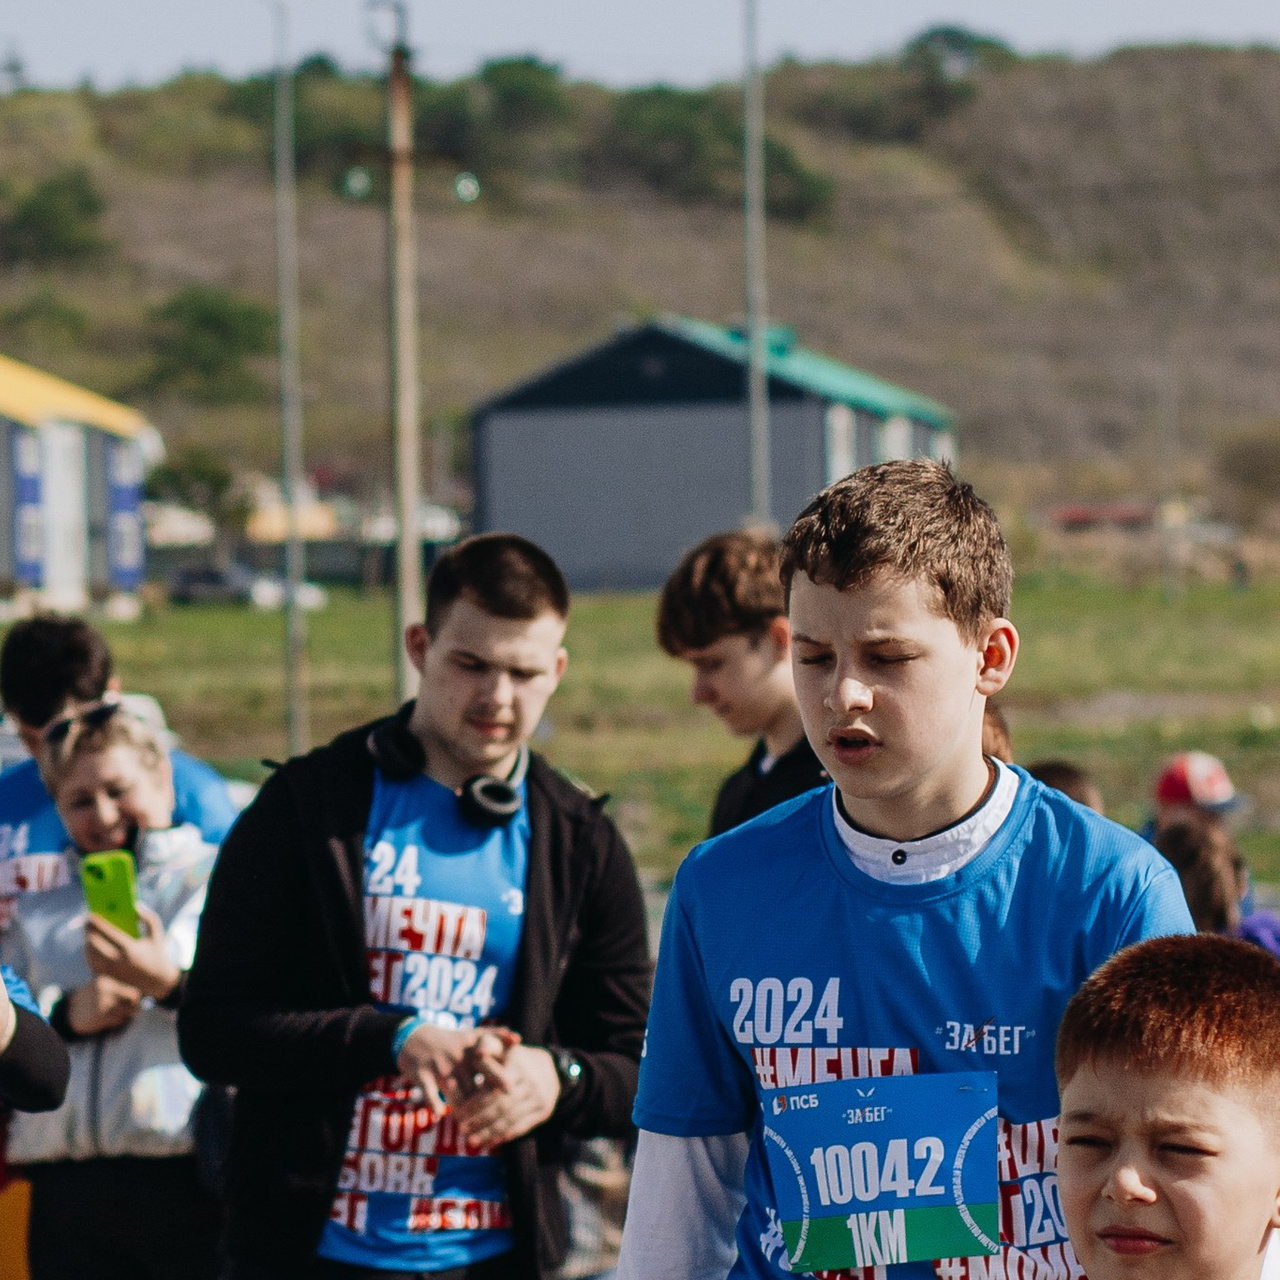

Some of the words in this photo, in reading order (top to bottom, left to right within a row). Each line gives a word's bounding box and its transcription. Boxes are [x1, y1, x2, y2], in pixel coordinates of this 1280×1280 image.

[730, 977, 844, 1044] 2024
[790, 1093, 819, 1111] ПСБ
[810, 1136, 946, 1206] 10042
[846, 1208, 908, 1268] 1КМ
